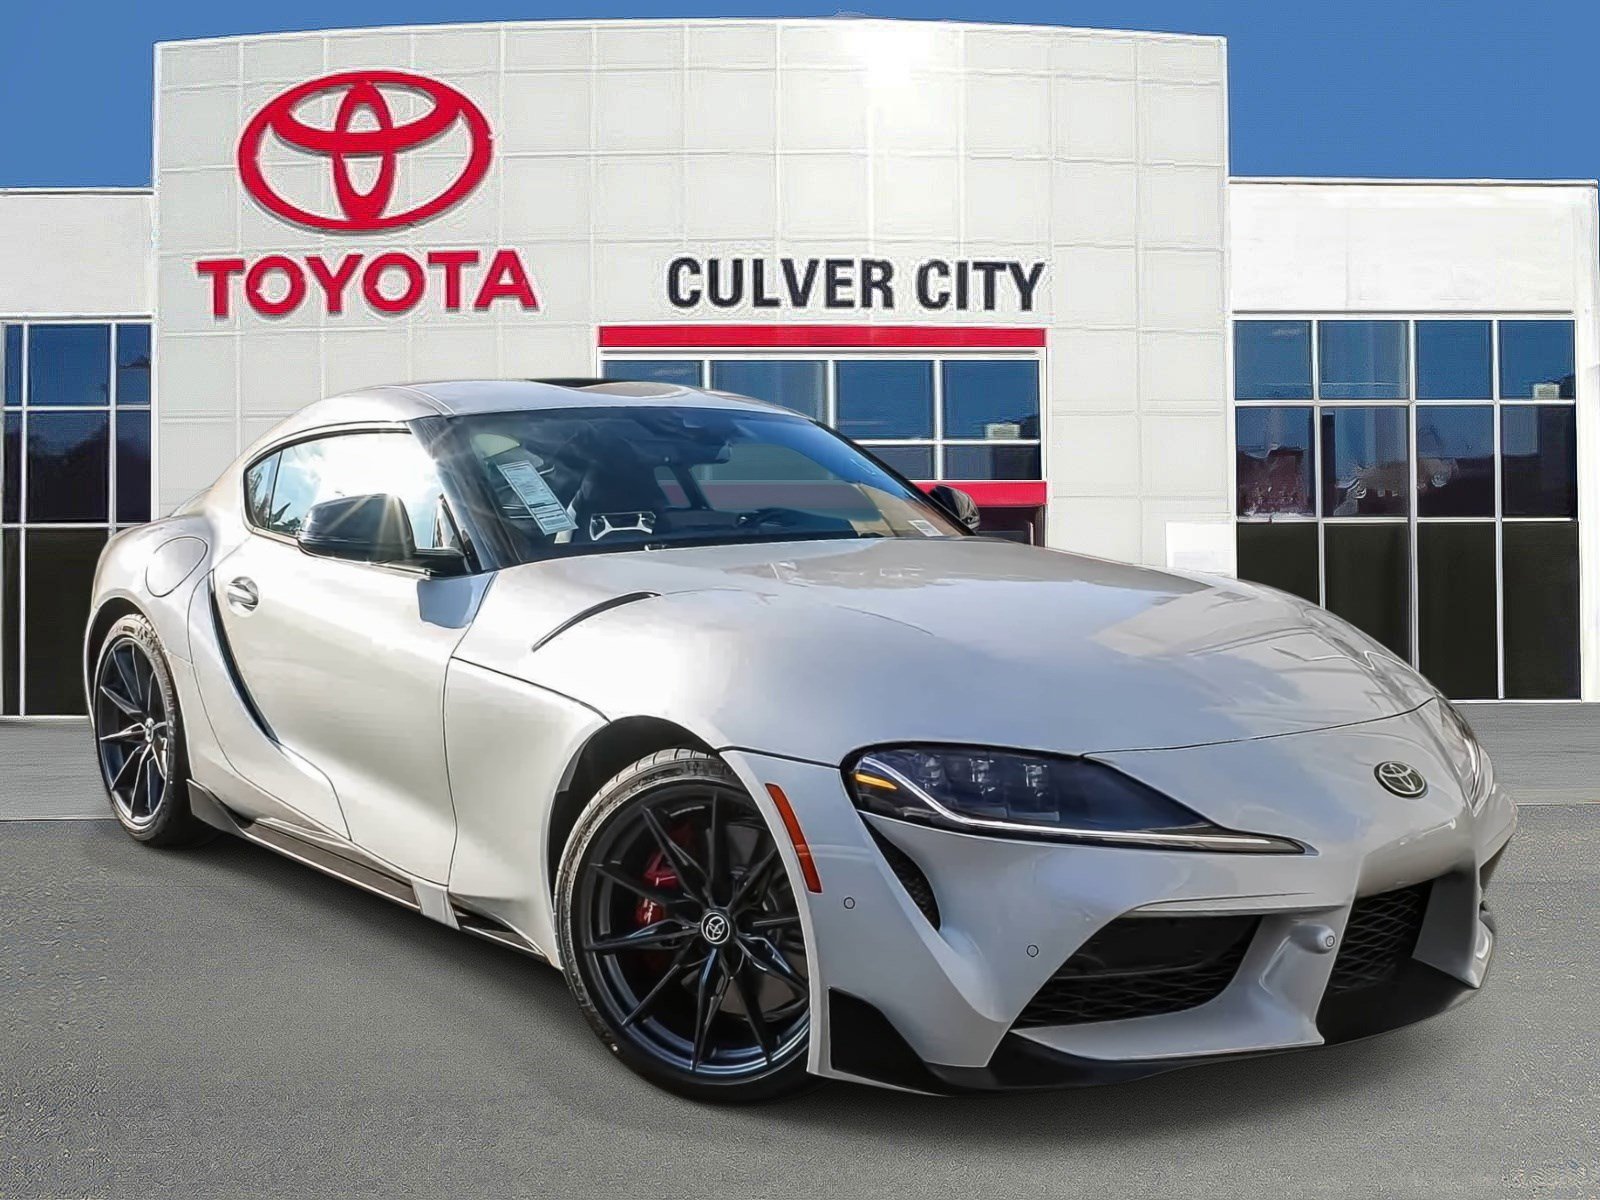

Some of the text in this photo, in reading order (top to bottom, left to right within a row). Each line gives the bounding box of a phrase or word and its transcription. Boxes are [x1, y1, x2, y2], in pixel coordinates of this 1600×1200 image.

[195, 249, 539, 319] TOYOTA
[667, 257, 1045, 311] CULVER CITY
